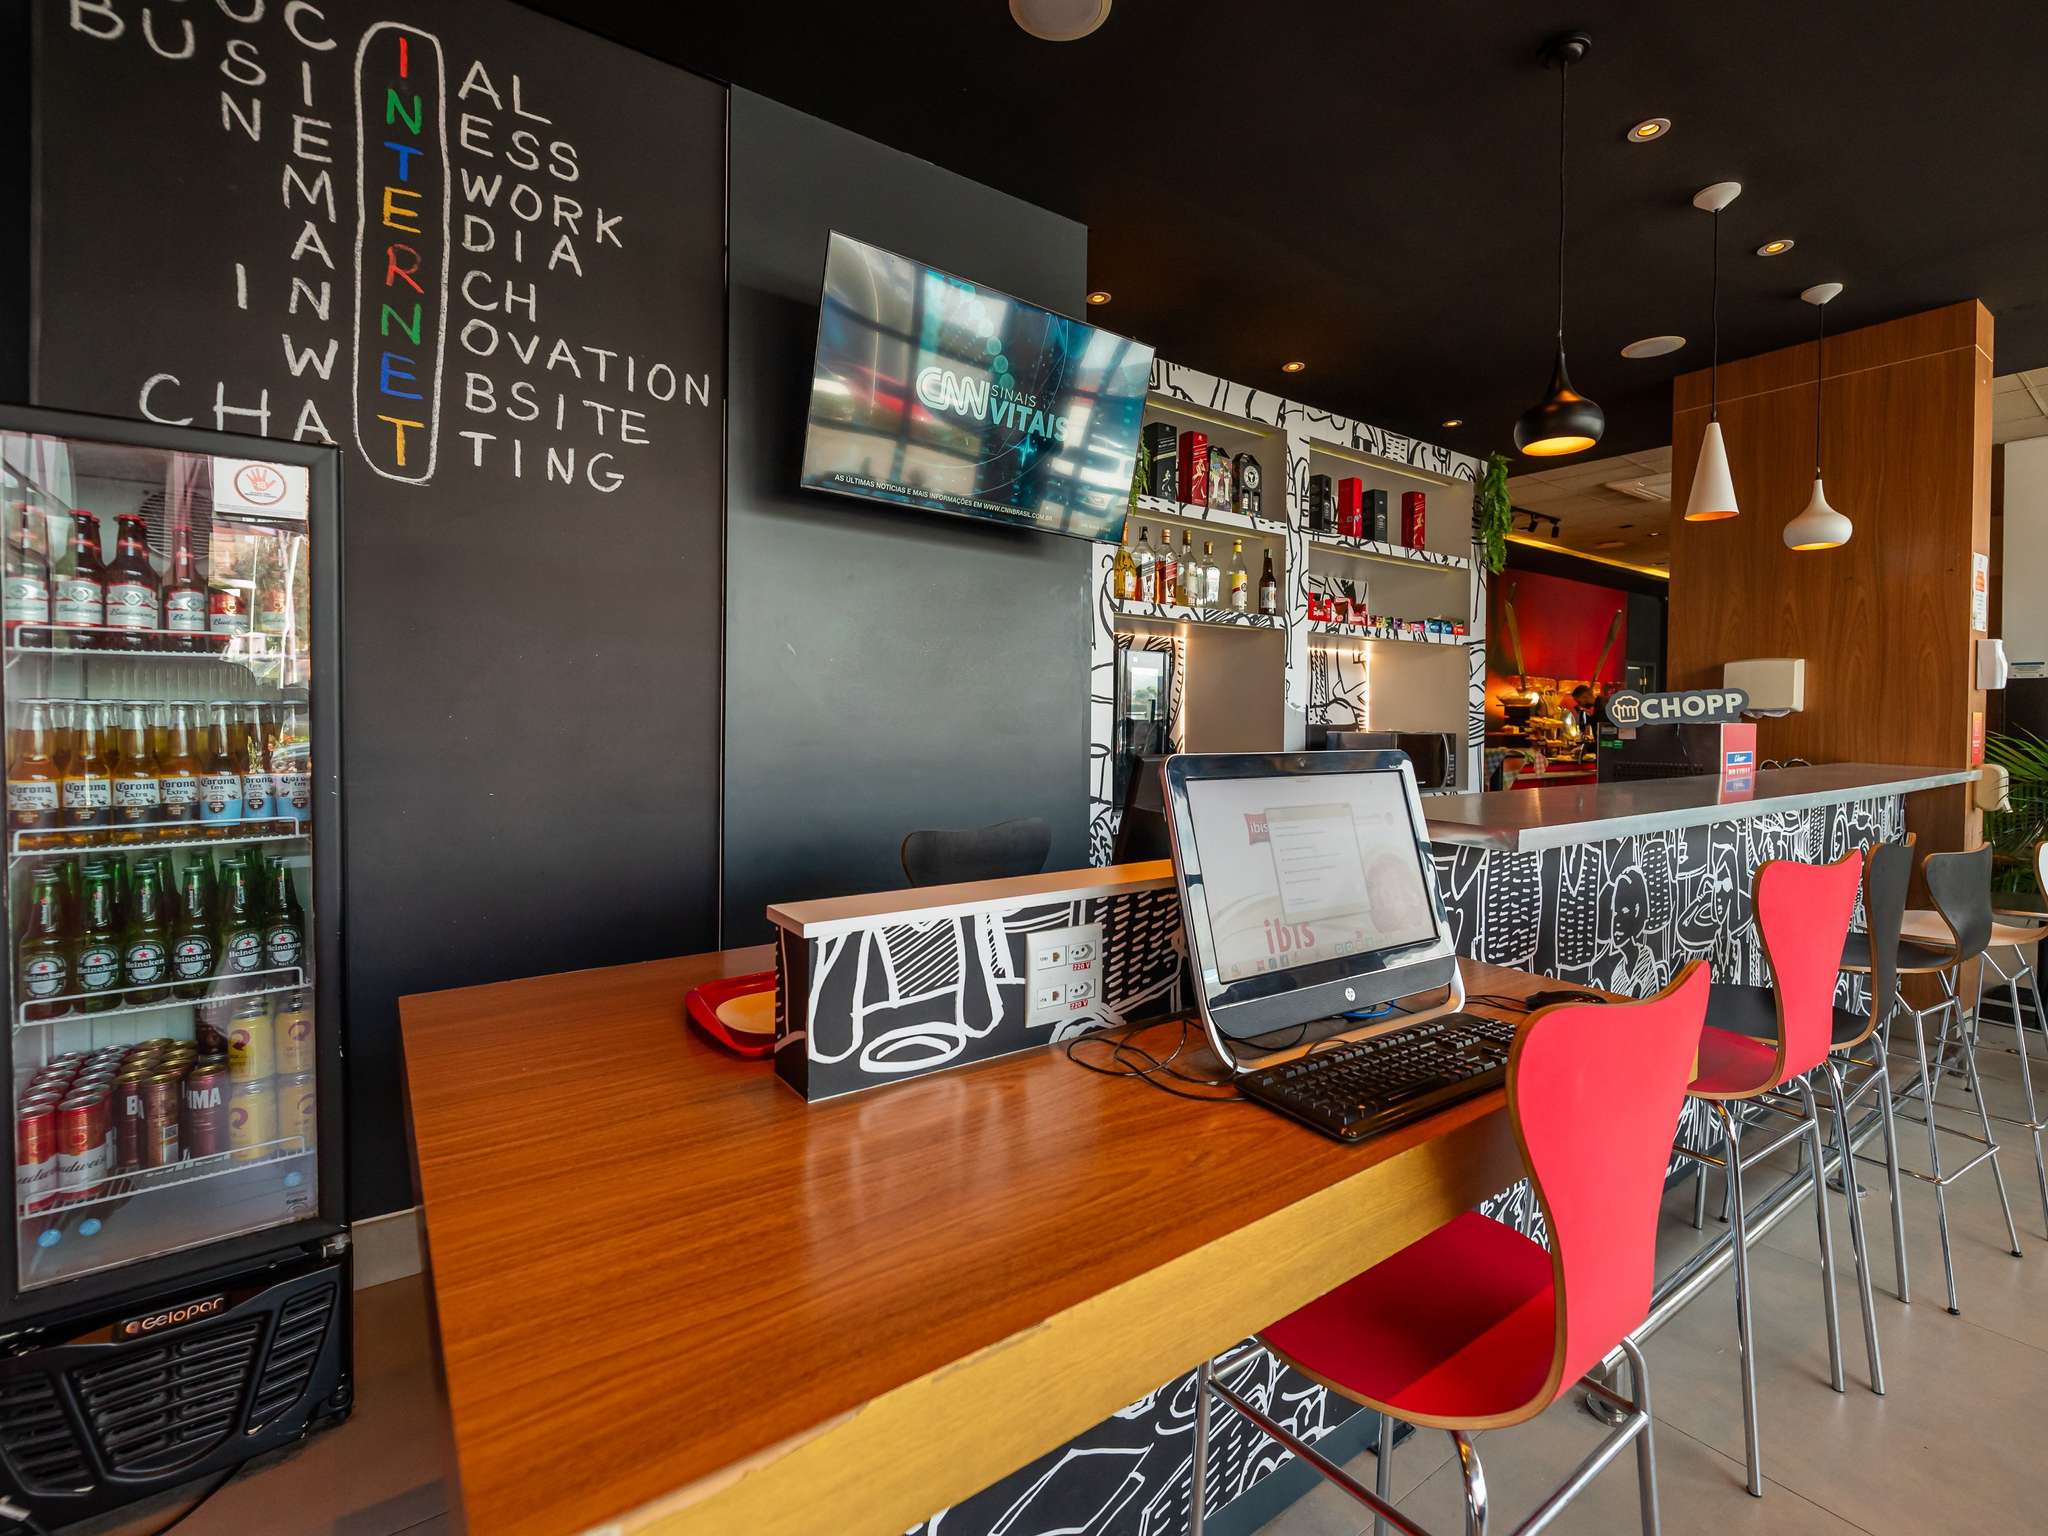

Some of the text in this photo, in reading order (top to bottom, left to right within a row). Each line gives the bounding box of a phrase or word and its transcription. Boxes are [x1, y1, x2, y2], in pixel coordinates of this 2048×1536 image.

[916, 366, 1037, 421] CNN SINAIS
[989, 398, 1070, 442] VITAIS
[834, 474, 845, 482] AS
[912, 489, 929, 498] MAIS
[973, 501, 983, 509] EM
[1640, 692, 1744, 720] CHOPP
[115, 780, 156, 793] Corona
[161, 778, 196, 791] Corona
[200, 777, 237, 787] Corona
[124, 791, 149, 799] Extra
[1264, 917, 1316, 954] ibis
[126, 958, 165, 969] Heineken
